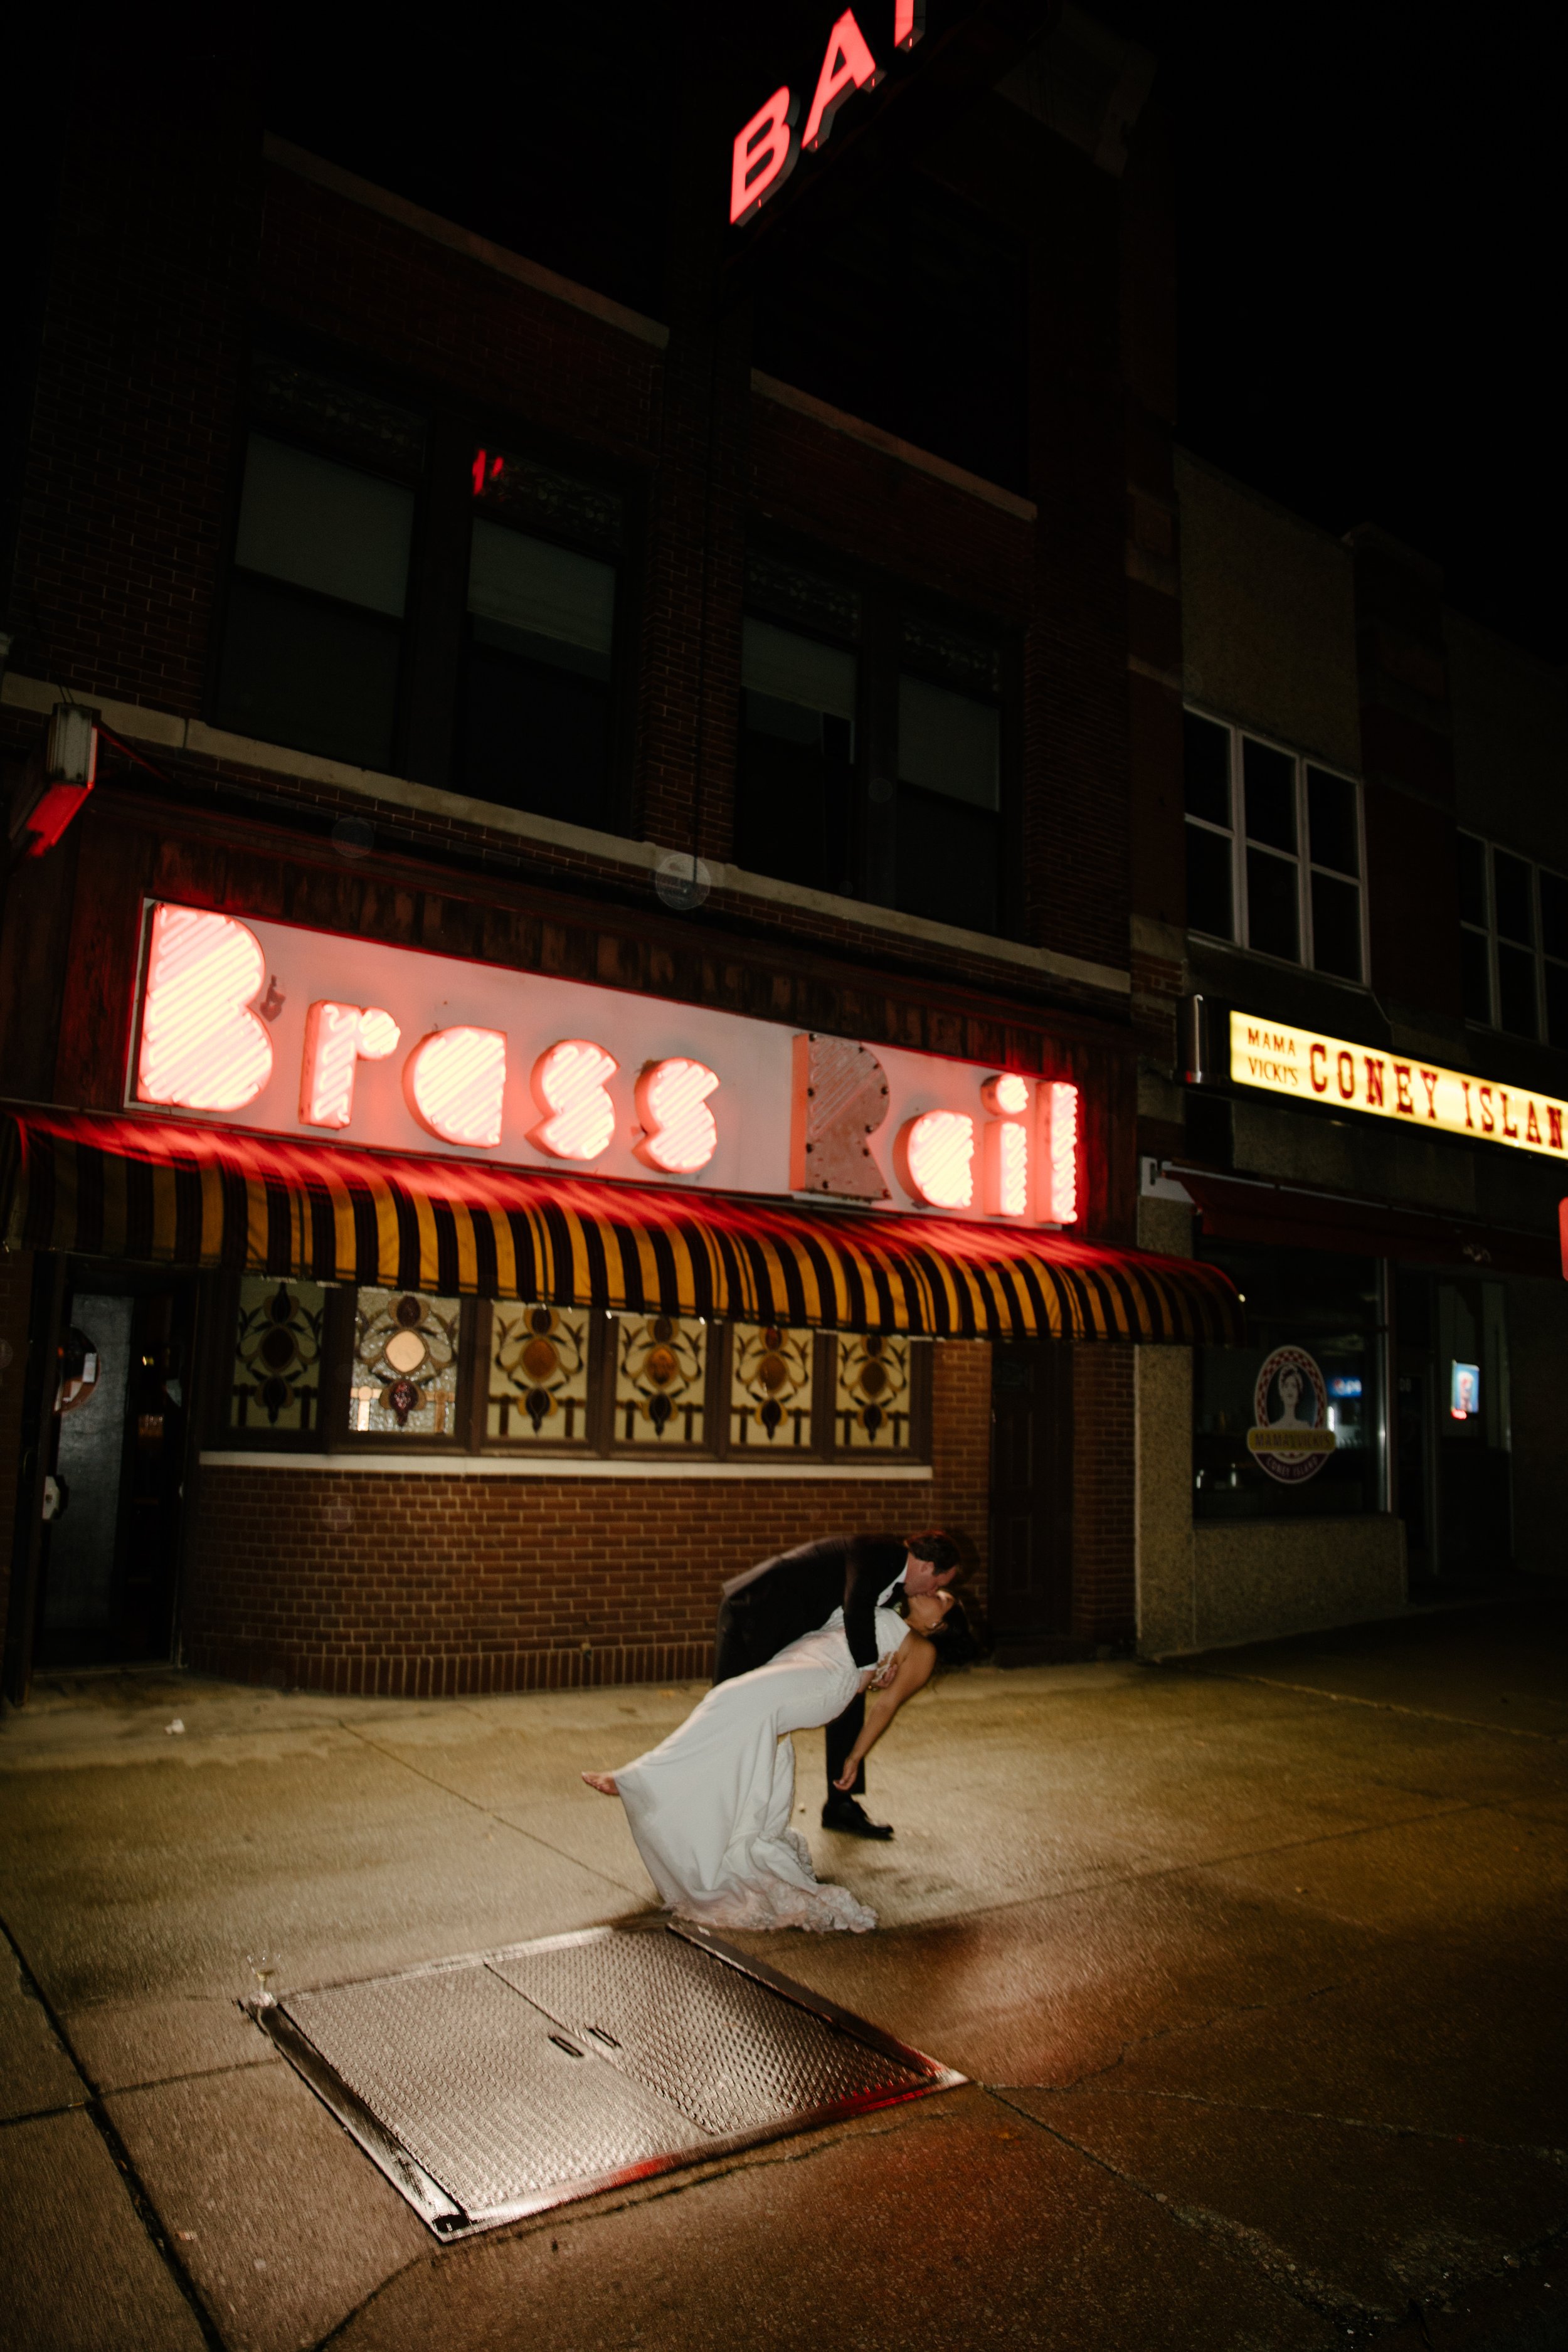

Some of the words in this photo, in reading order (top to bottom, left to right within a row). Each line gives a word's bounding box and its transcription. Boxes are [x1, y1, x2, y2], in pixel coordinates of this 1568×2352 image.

[137, 902, 721, 1174] Brass
[790, 1033, 1079, 1225] Rail
[1248, 1027, 1296, 1057] MAMA
[1248, 1056, 1298, 1087] VICKI'S
[1310, 1042, 1438, 1120] CONEY
